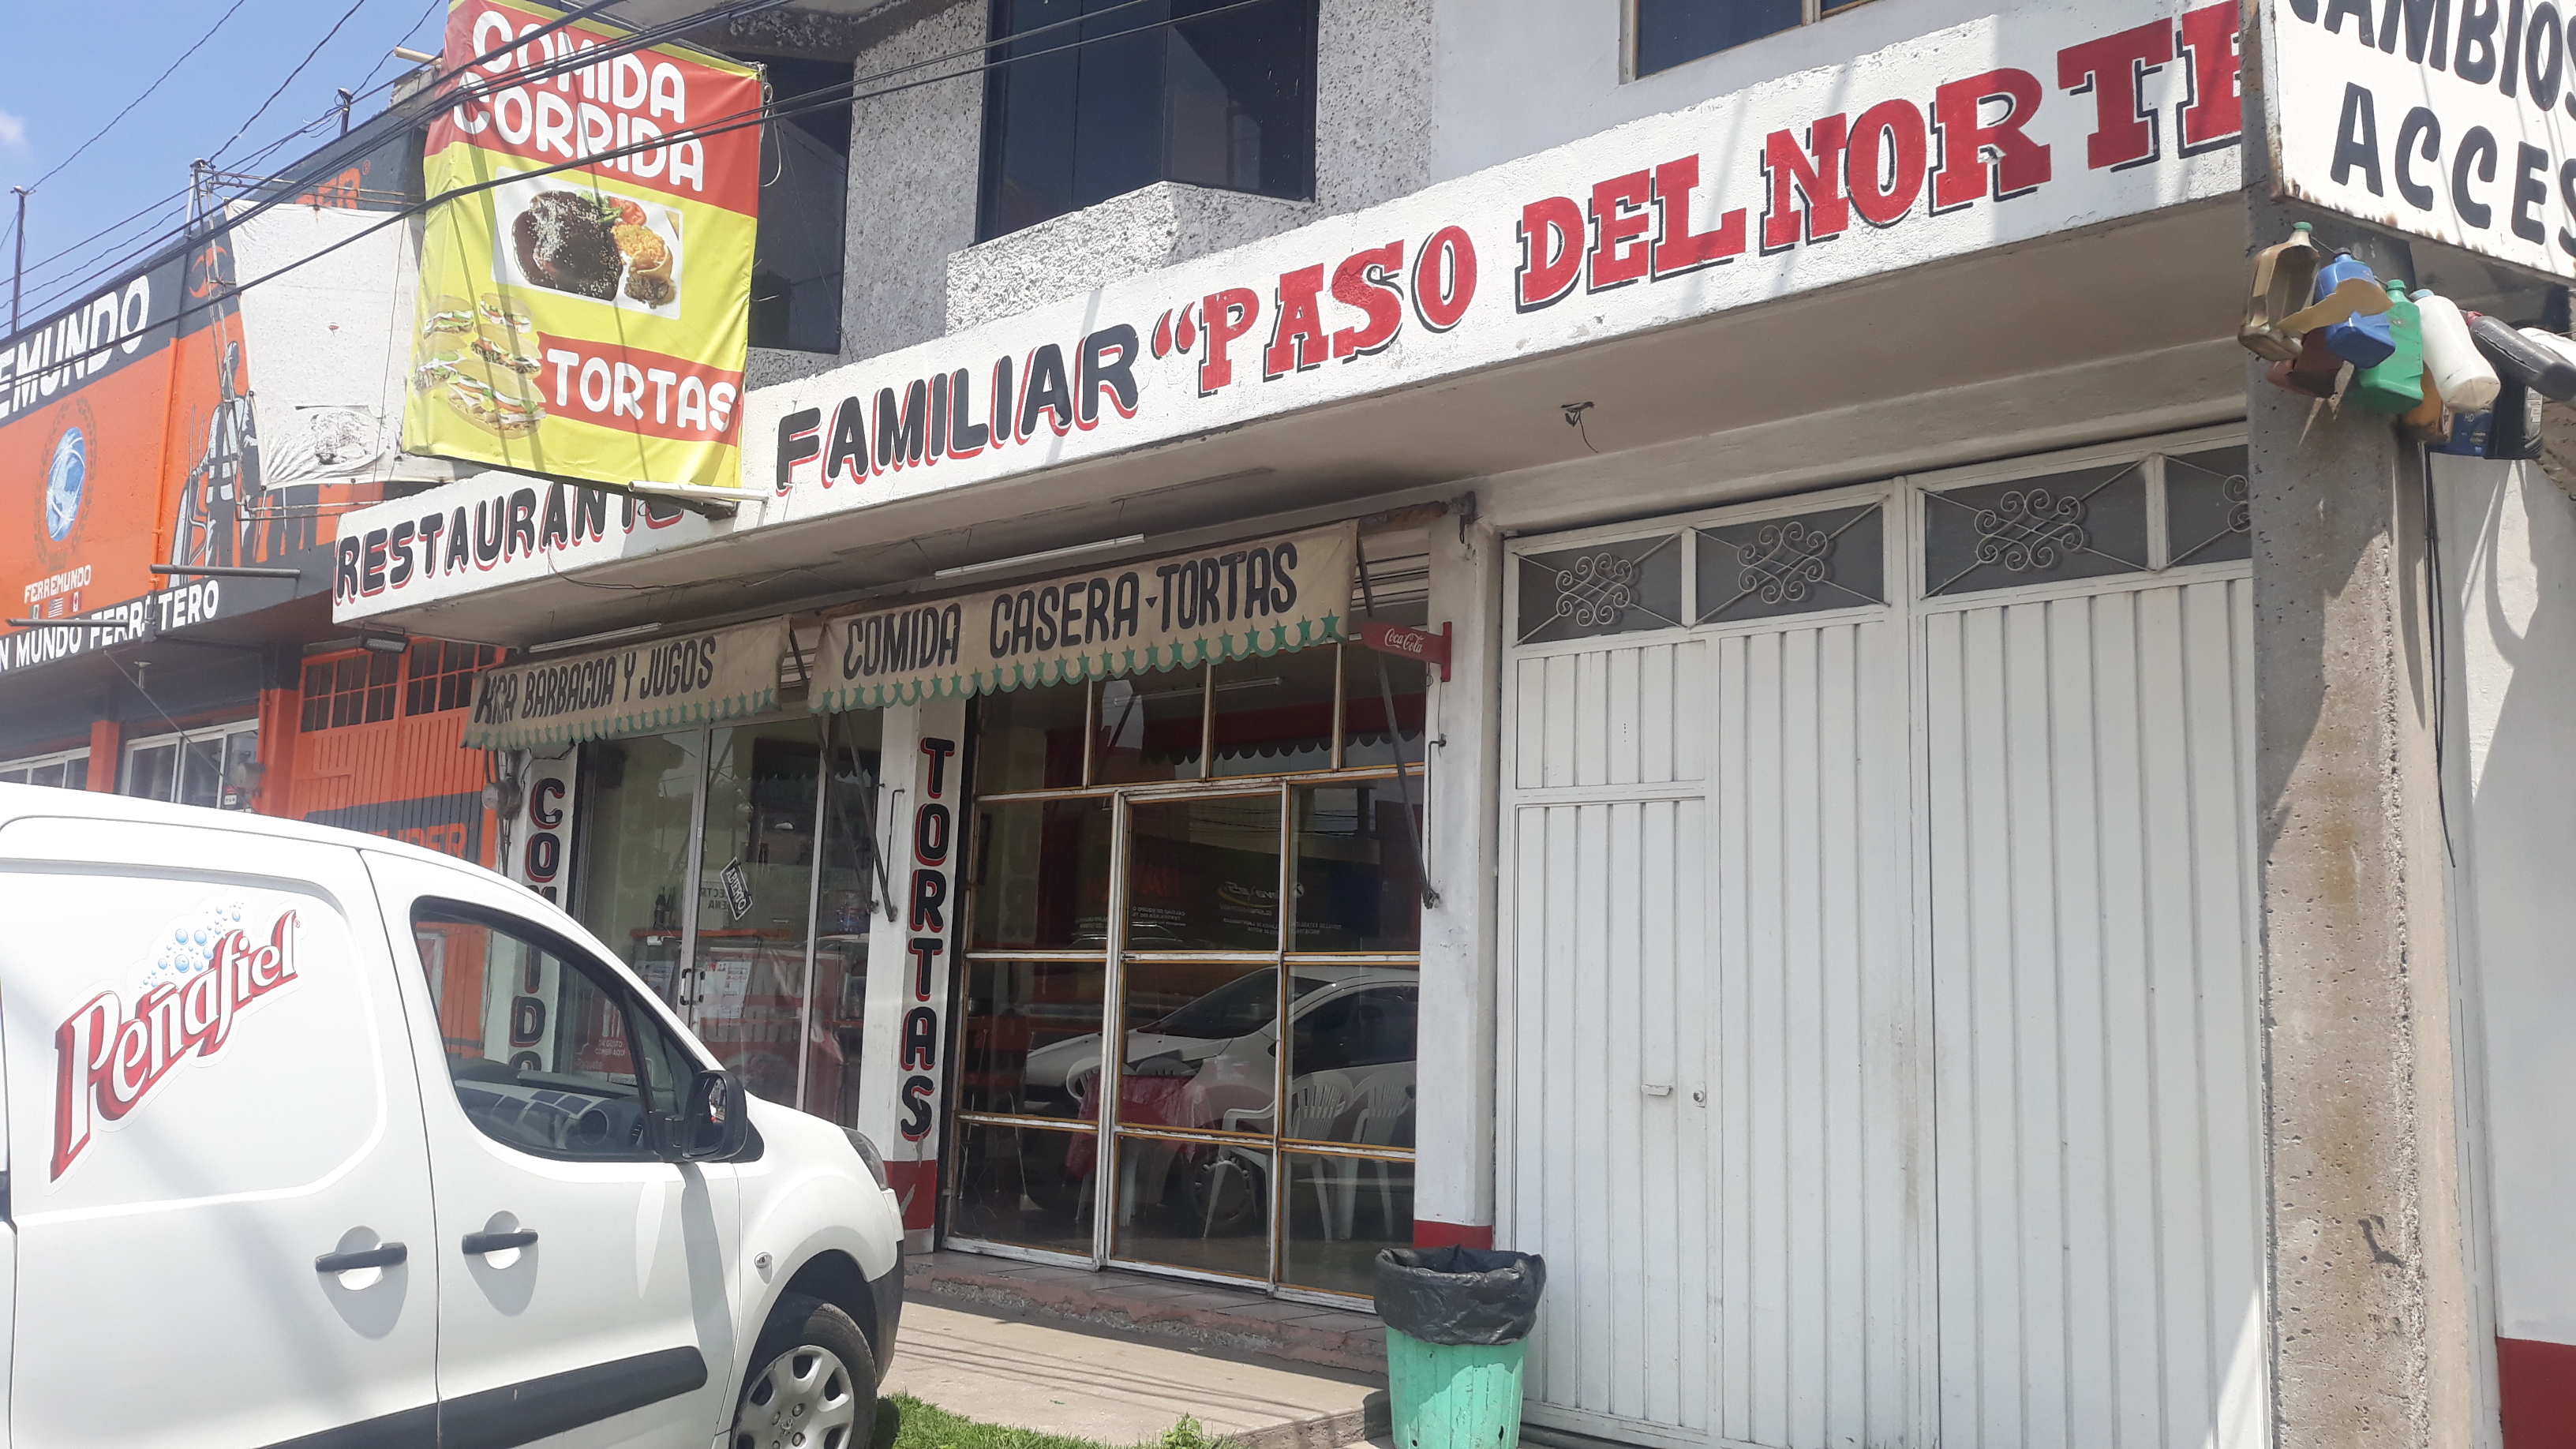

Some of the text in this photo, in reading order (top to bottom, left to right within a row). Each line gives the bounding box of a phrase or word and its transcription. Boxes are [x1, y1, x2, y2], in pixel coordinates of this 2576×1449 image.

[473, 10, 686, 124] COMIDA
[2291, 0, 2576, 111] MBIO
[453, 73, 705, 192] CORRIDA
[776, 324, 1139, 496] FAMILIAR
[1515, 153, 1747, 314] DEL
[1759, 0, 2242, 257] NORTE
[547, 348, 737, 432] TORTAS
[24, 564, 92, 604] FERREMUNDO
[844, 542, 1297, 680] COMIDA CASERA TORTAS
[16, 618, 82, 668] MUNDO
[521, 656, 616, 719] BARBACOA
[623, 653, 637, 702] Y
[639, 637, 717, 700] JUGOS
[510, 777, 566, 1072] COID
[726, 867, 747, 910] ABIERTO
[900, 736, 955, 1142] TORTAS
[51, 909, 299, 1183] Peñafiel
